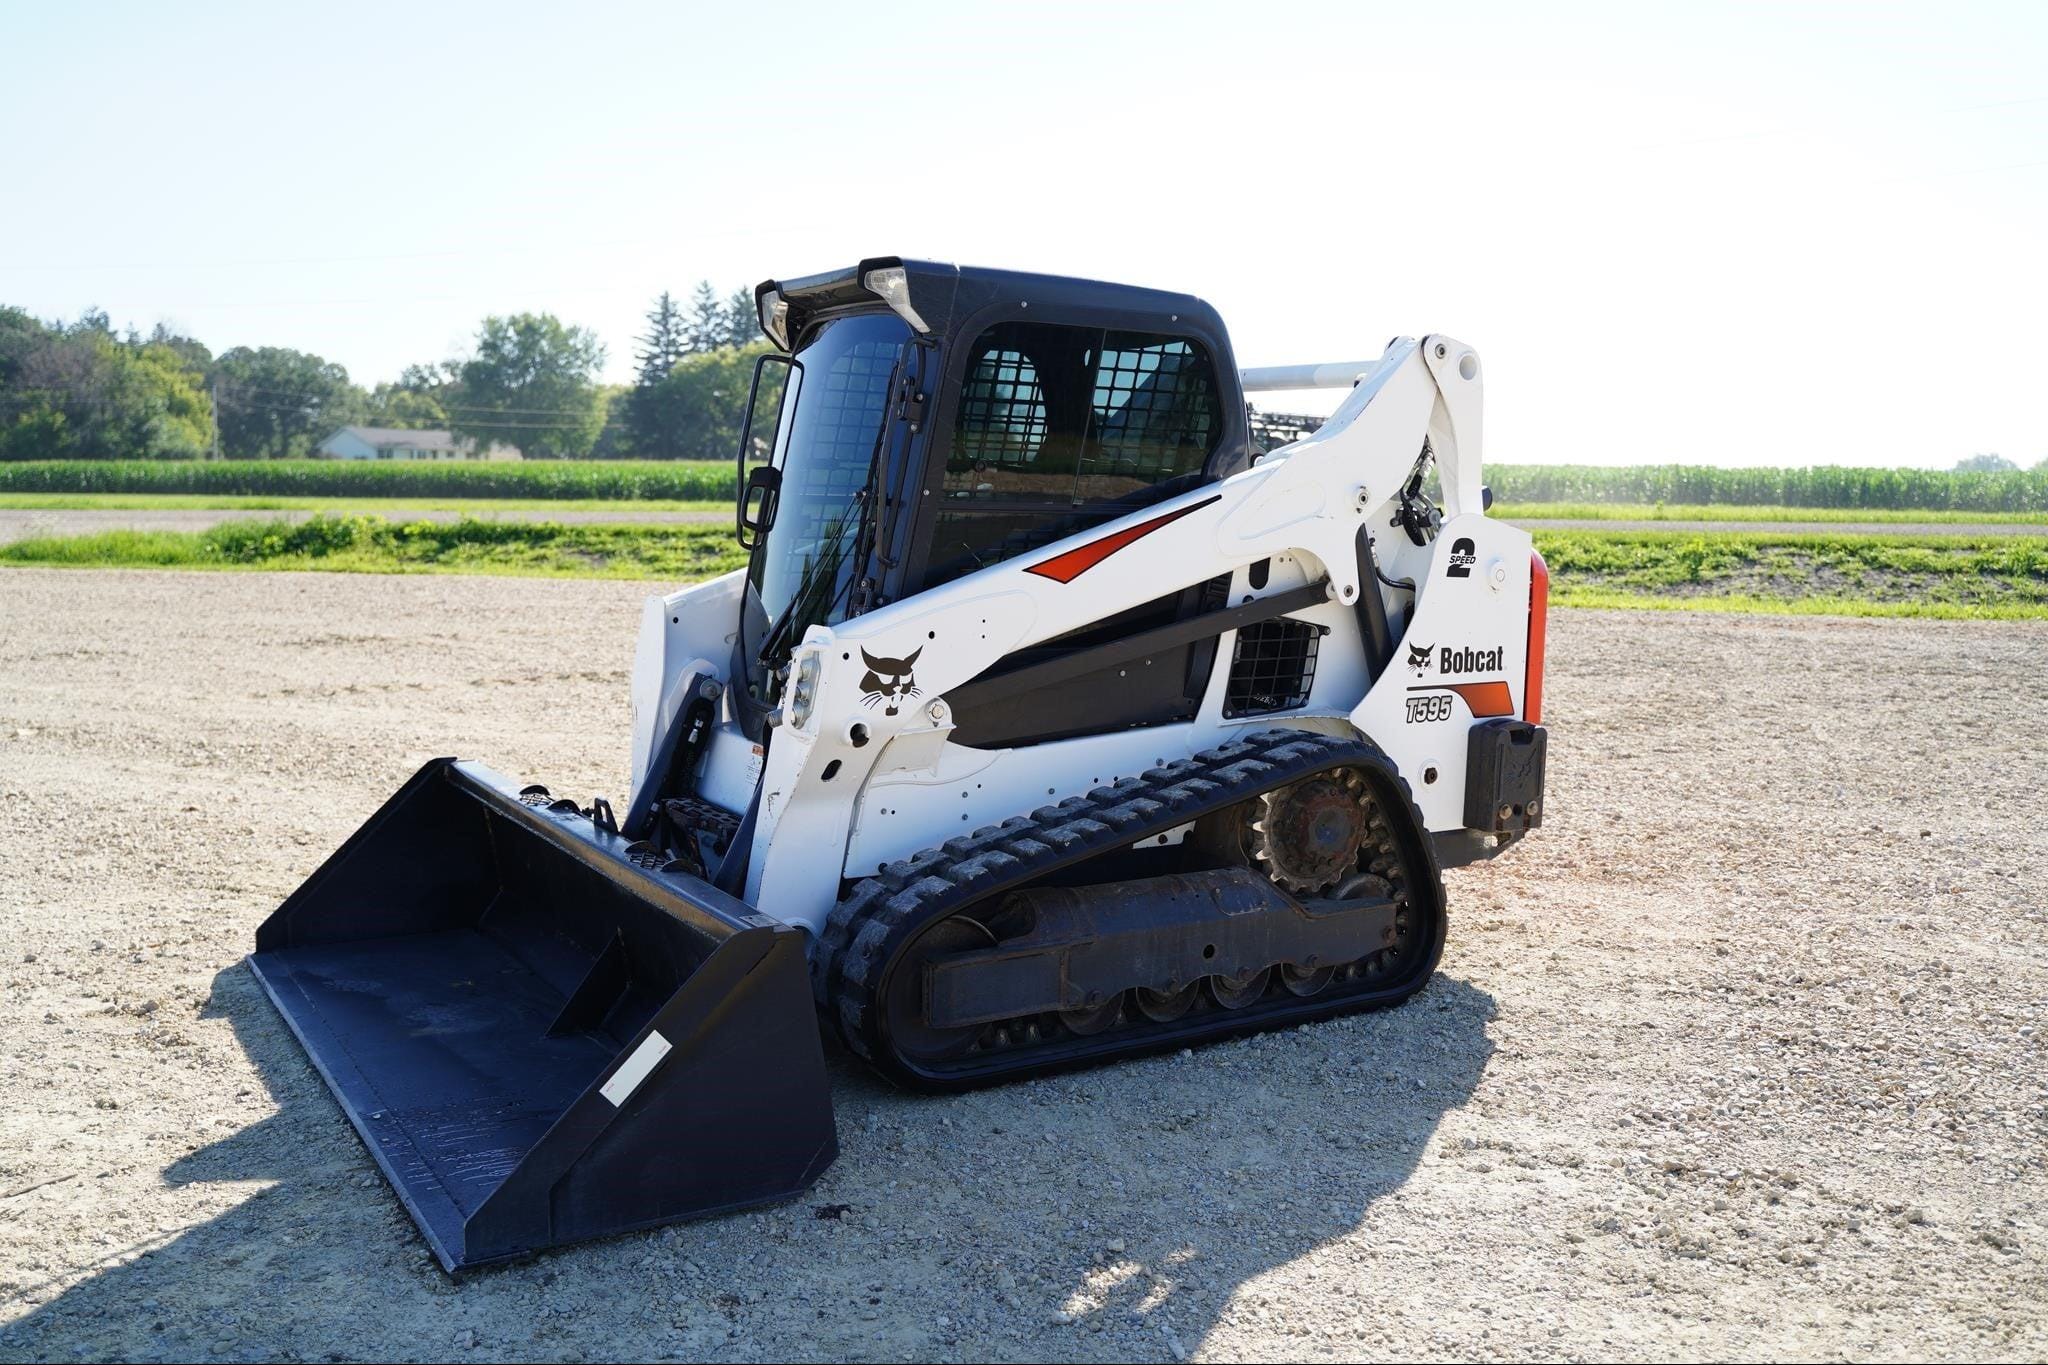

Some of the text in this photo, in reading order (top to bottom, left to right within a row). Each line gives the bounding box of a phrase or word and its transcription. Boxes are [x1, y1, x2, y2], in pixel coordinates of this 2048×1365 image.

[1446, 537, 1475, 578] 2
[1449, 555, 1477, 564] SPEED
[1440, 646, 1503, 674] Bobcat
[1406, 695, 1453, 723] T595
